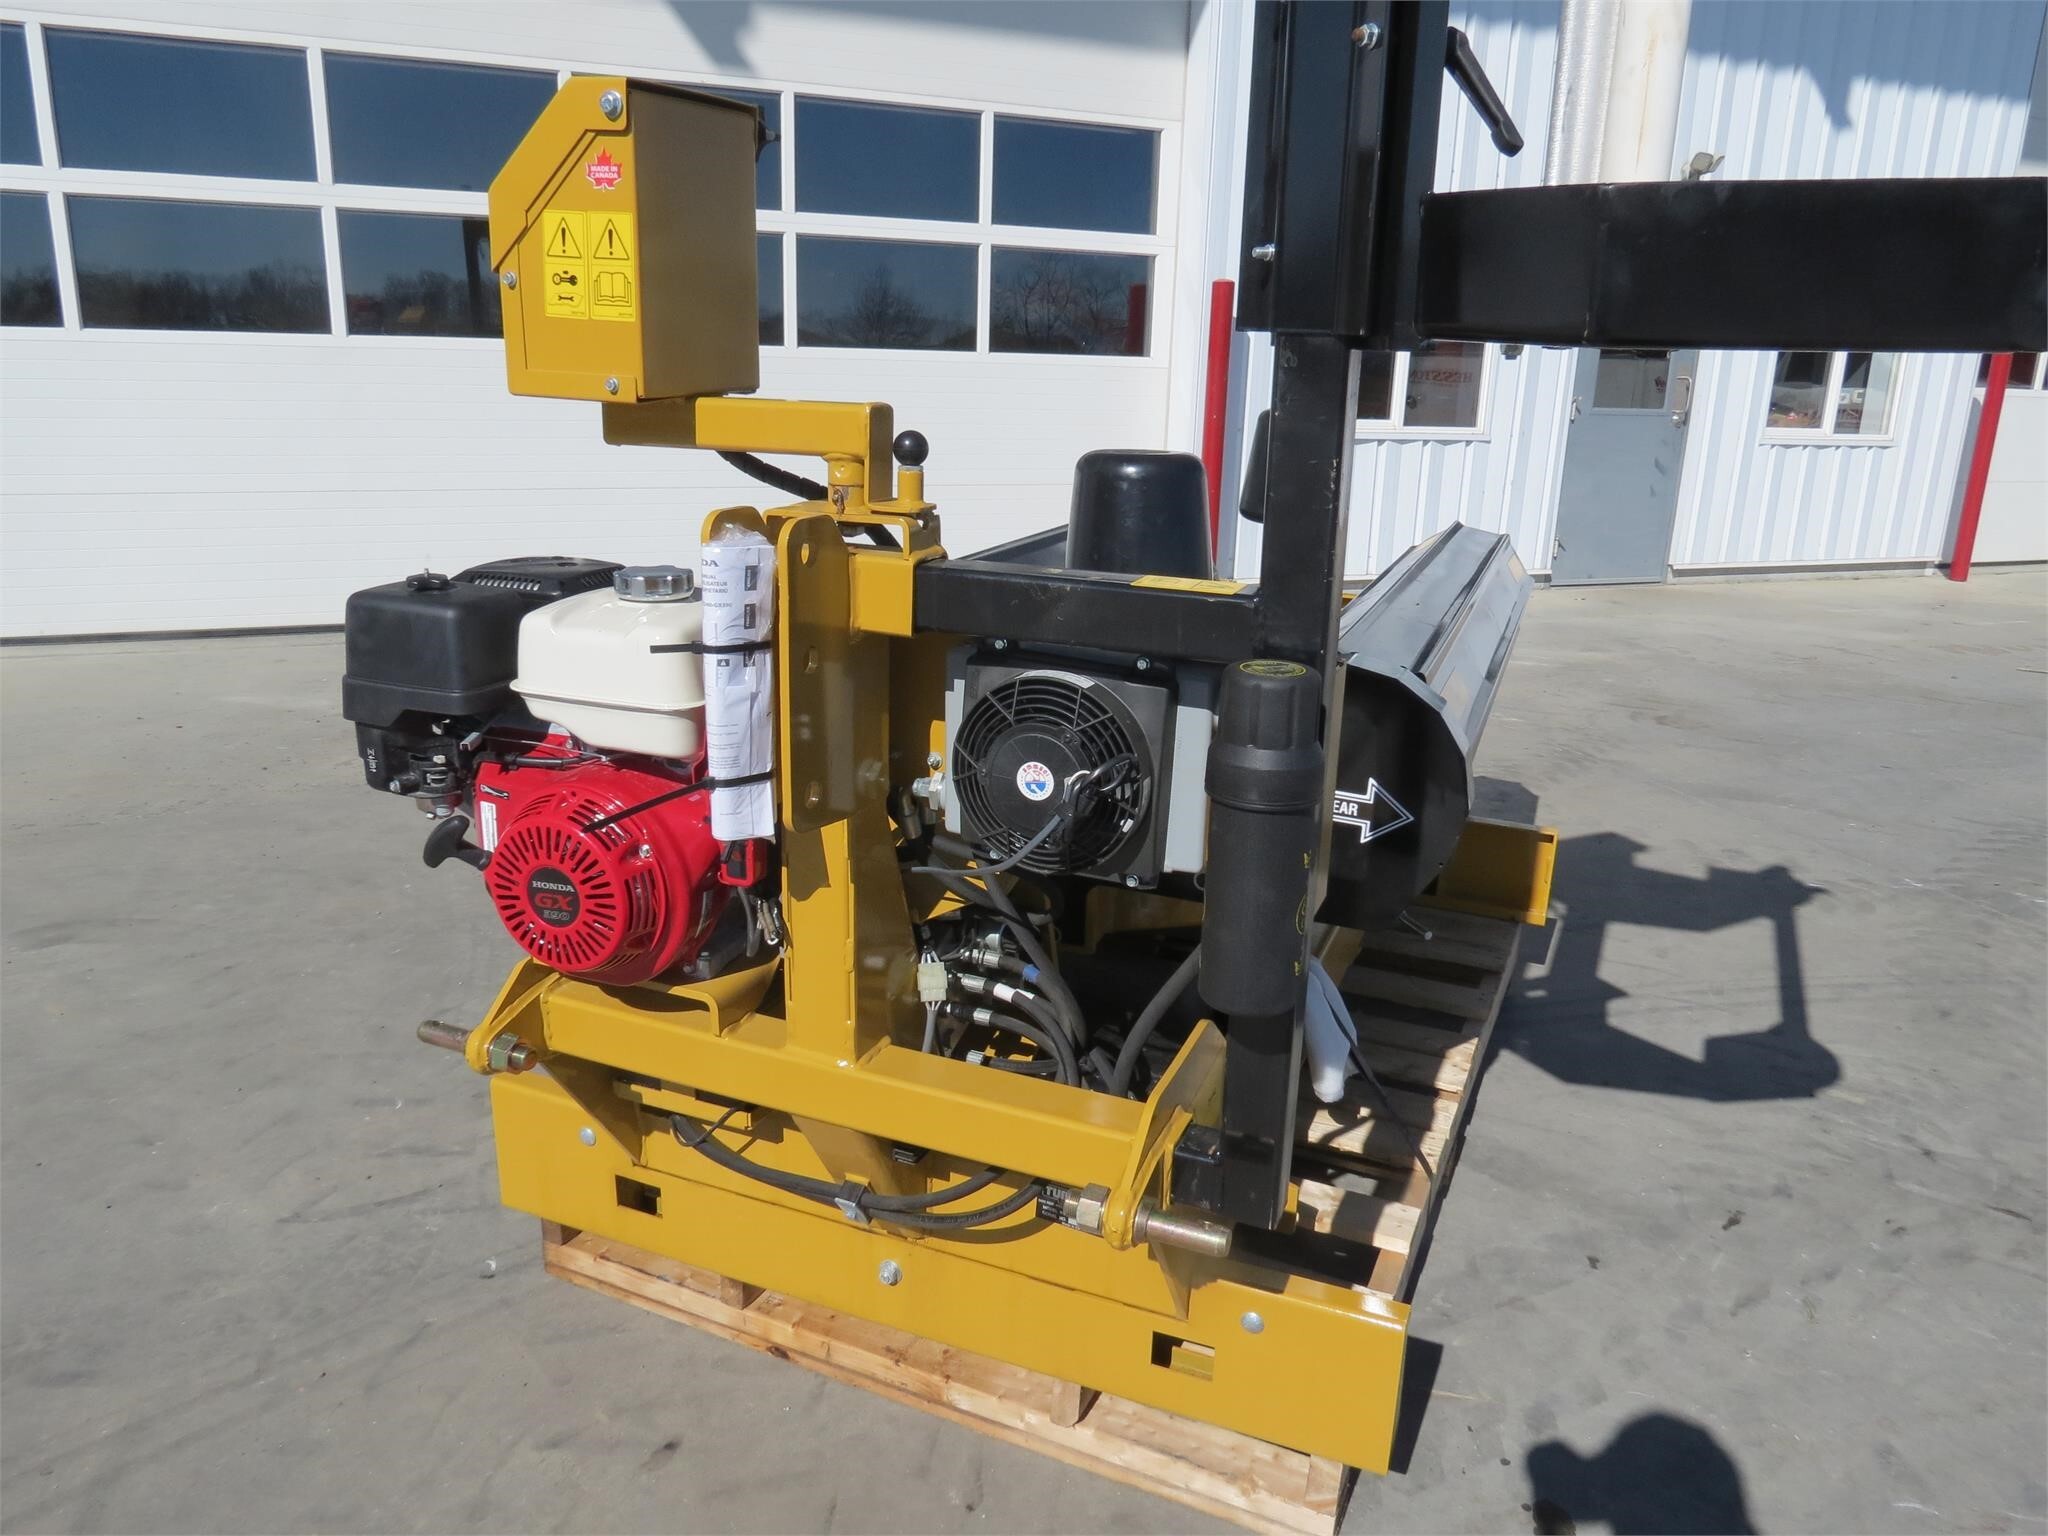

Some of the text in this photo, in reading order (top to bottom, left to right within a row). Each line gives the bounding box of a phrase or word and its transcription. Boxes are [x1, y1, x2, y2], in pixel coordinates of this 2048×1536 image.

[590, 171, 618, 179] CANADA
[1333, 800, 1359, 816] EAR
[531, 880, 576, 893] HONDA
[535, 893, 573, 911] GX
